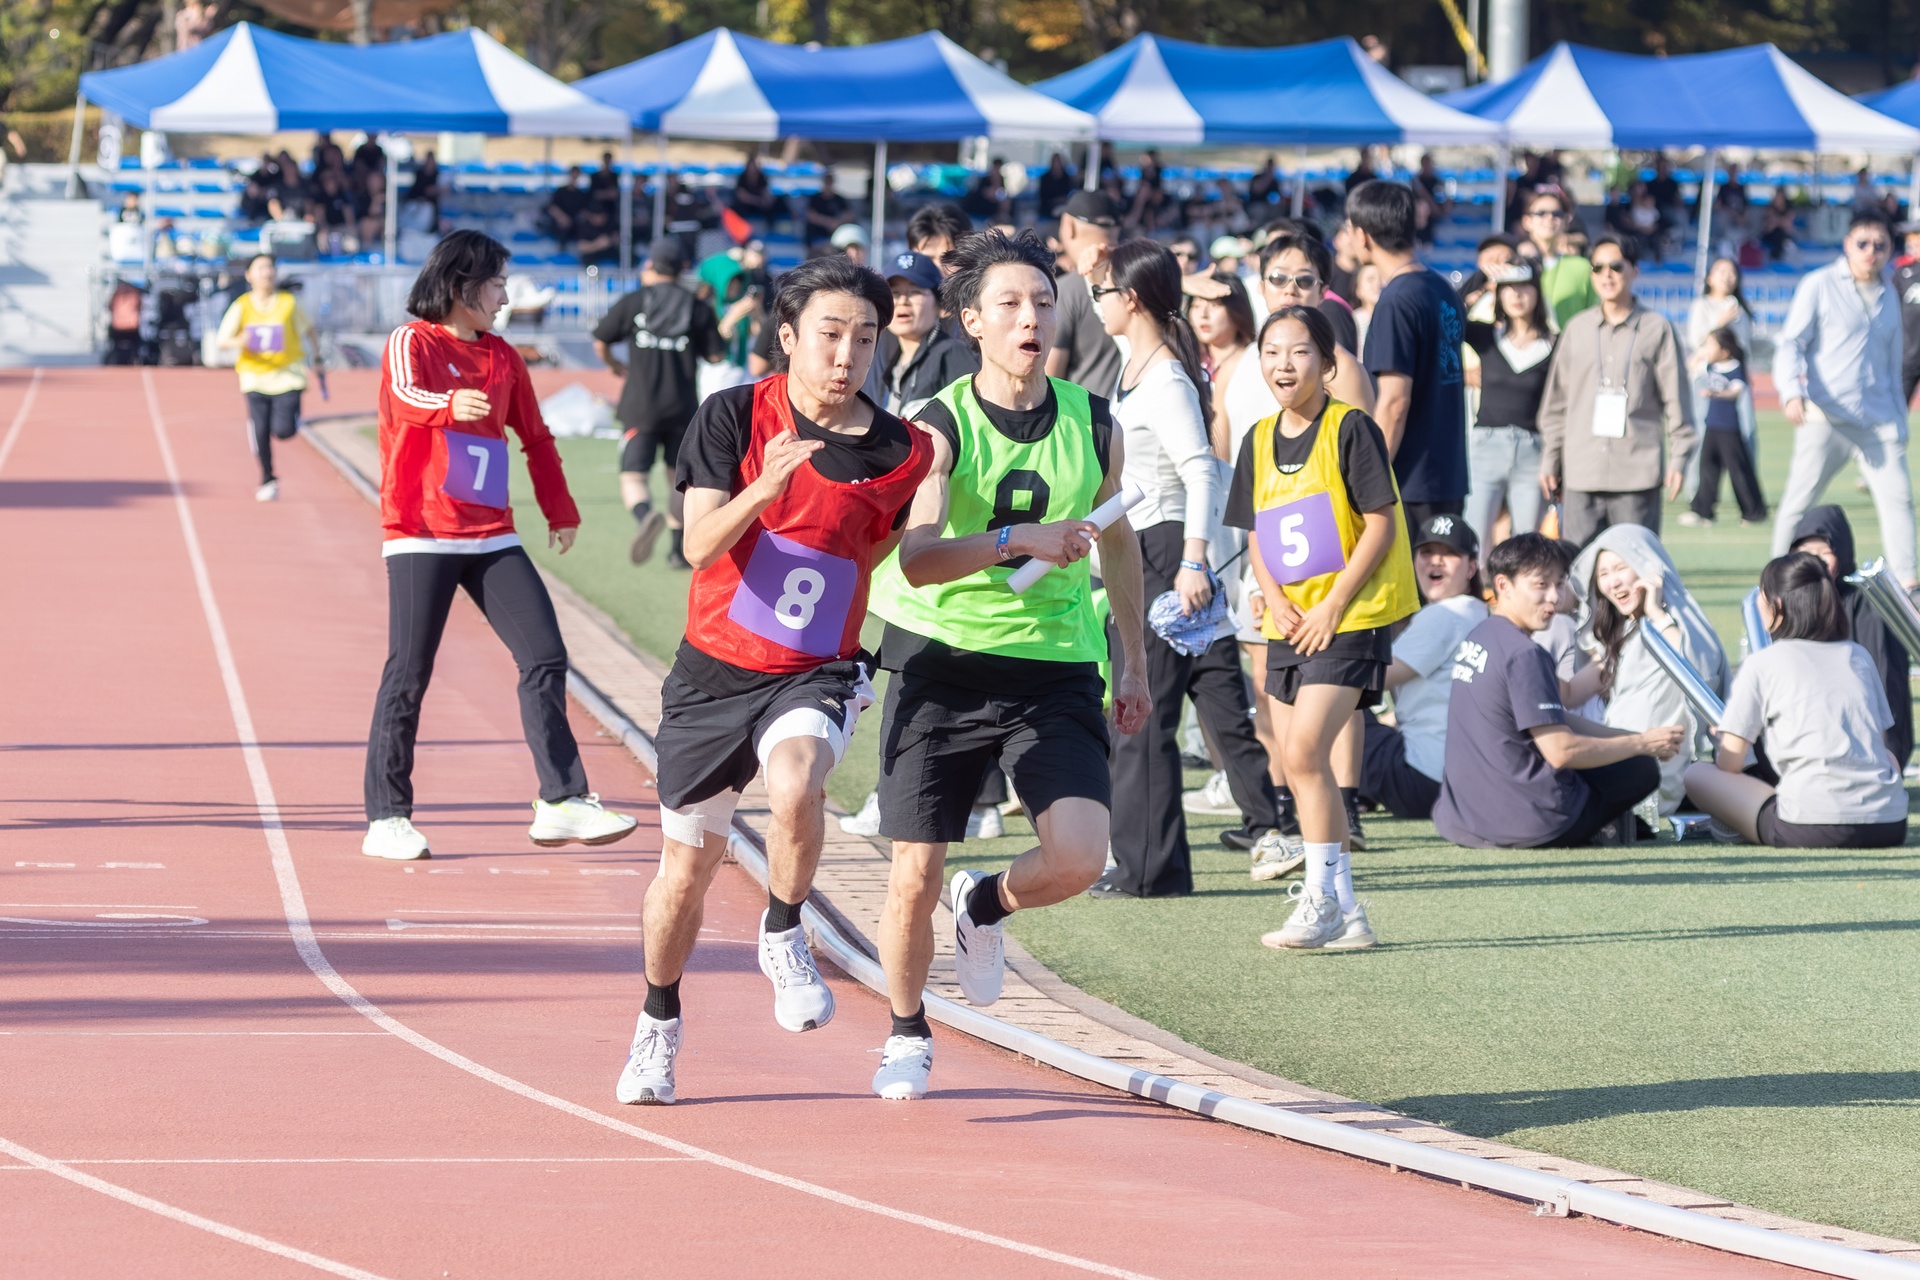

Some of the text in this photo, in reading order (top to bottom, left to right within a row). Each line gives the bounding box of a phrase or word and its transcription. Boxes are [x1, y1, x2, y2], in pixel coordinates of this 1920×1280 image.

[255, 327, 274, 351] 7
[467, 445, 490, 491] 7
[1279, 512, 1310, 567] 5
[1431, 516, 1454, 536] NY
[774, 567, 826, 630] 8
